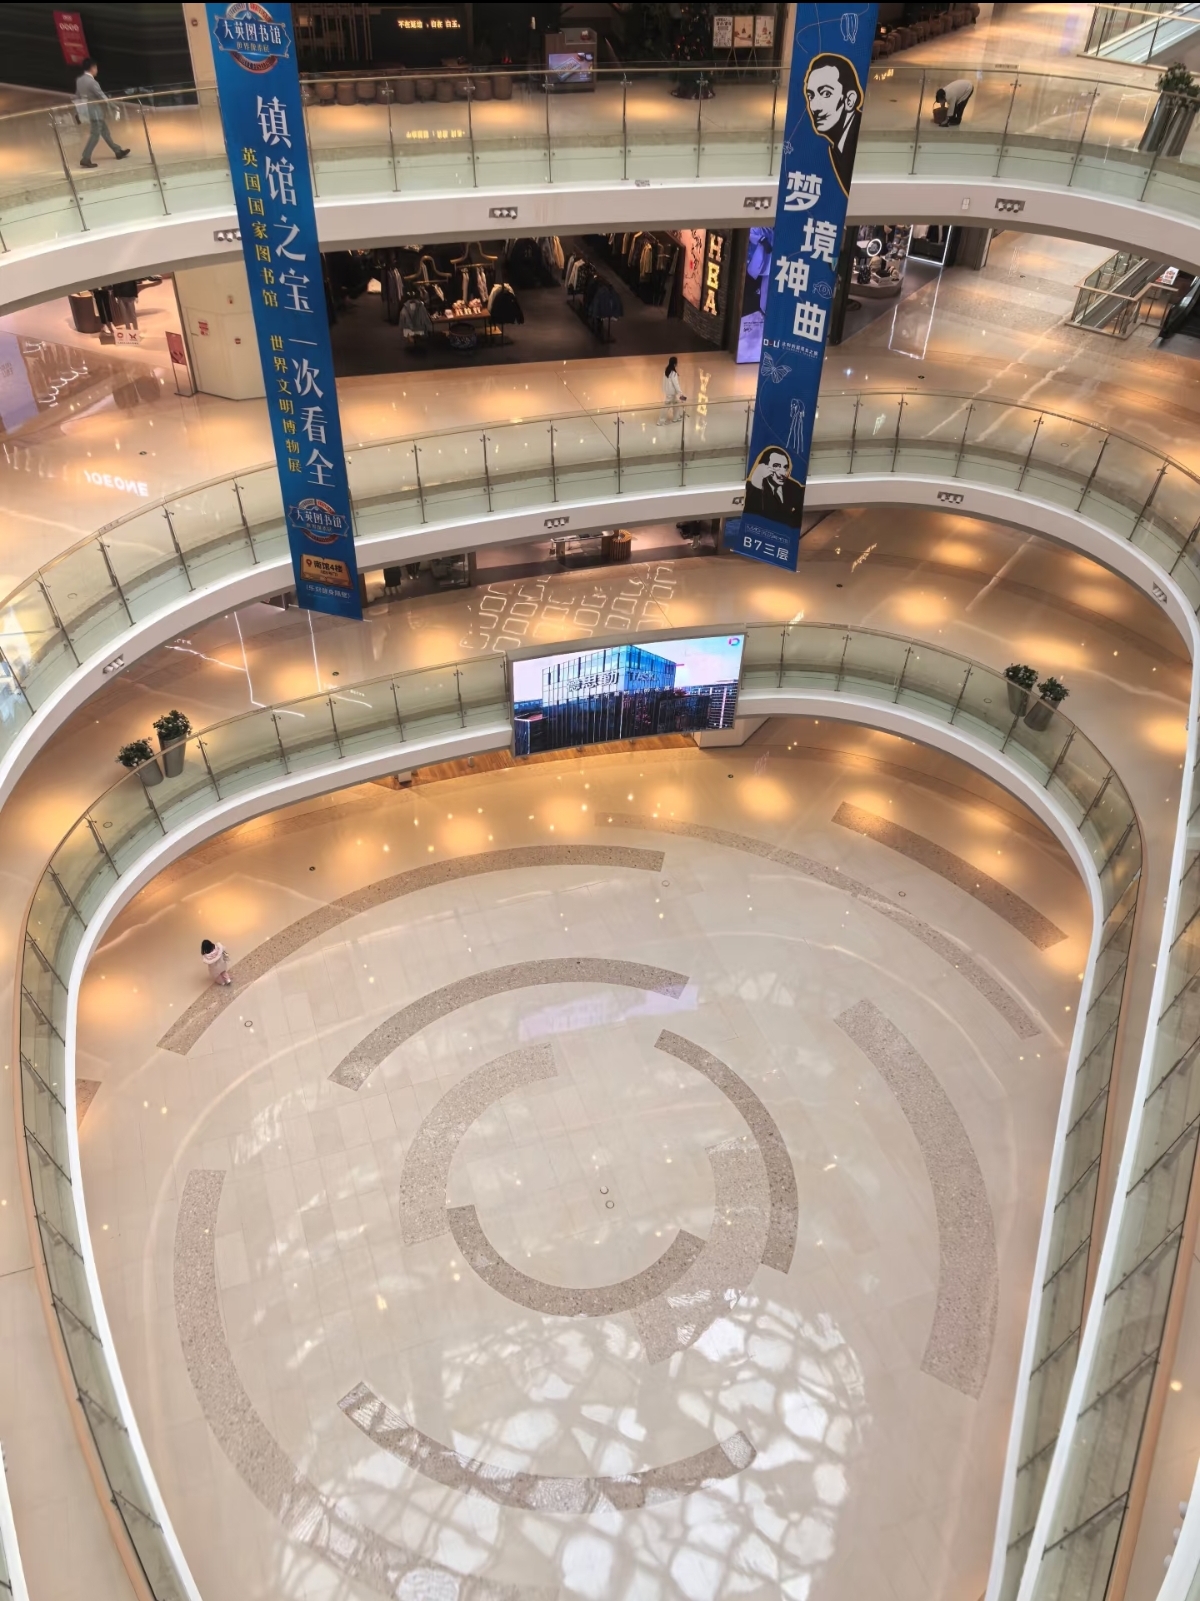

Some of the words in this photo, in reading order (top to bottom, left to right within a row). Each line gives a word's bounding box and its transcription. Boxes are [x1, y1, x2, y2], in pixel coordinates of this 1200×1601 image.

[222, 20, 282, 45] 大英图书馆
[241, 146, 278, 309] 英国国家图书馆
[270, 334, 302, 473] 世界文明博物展
[296, 509, 342, 529] 大英图书馆
